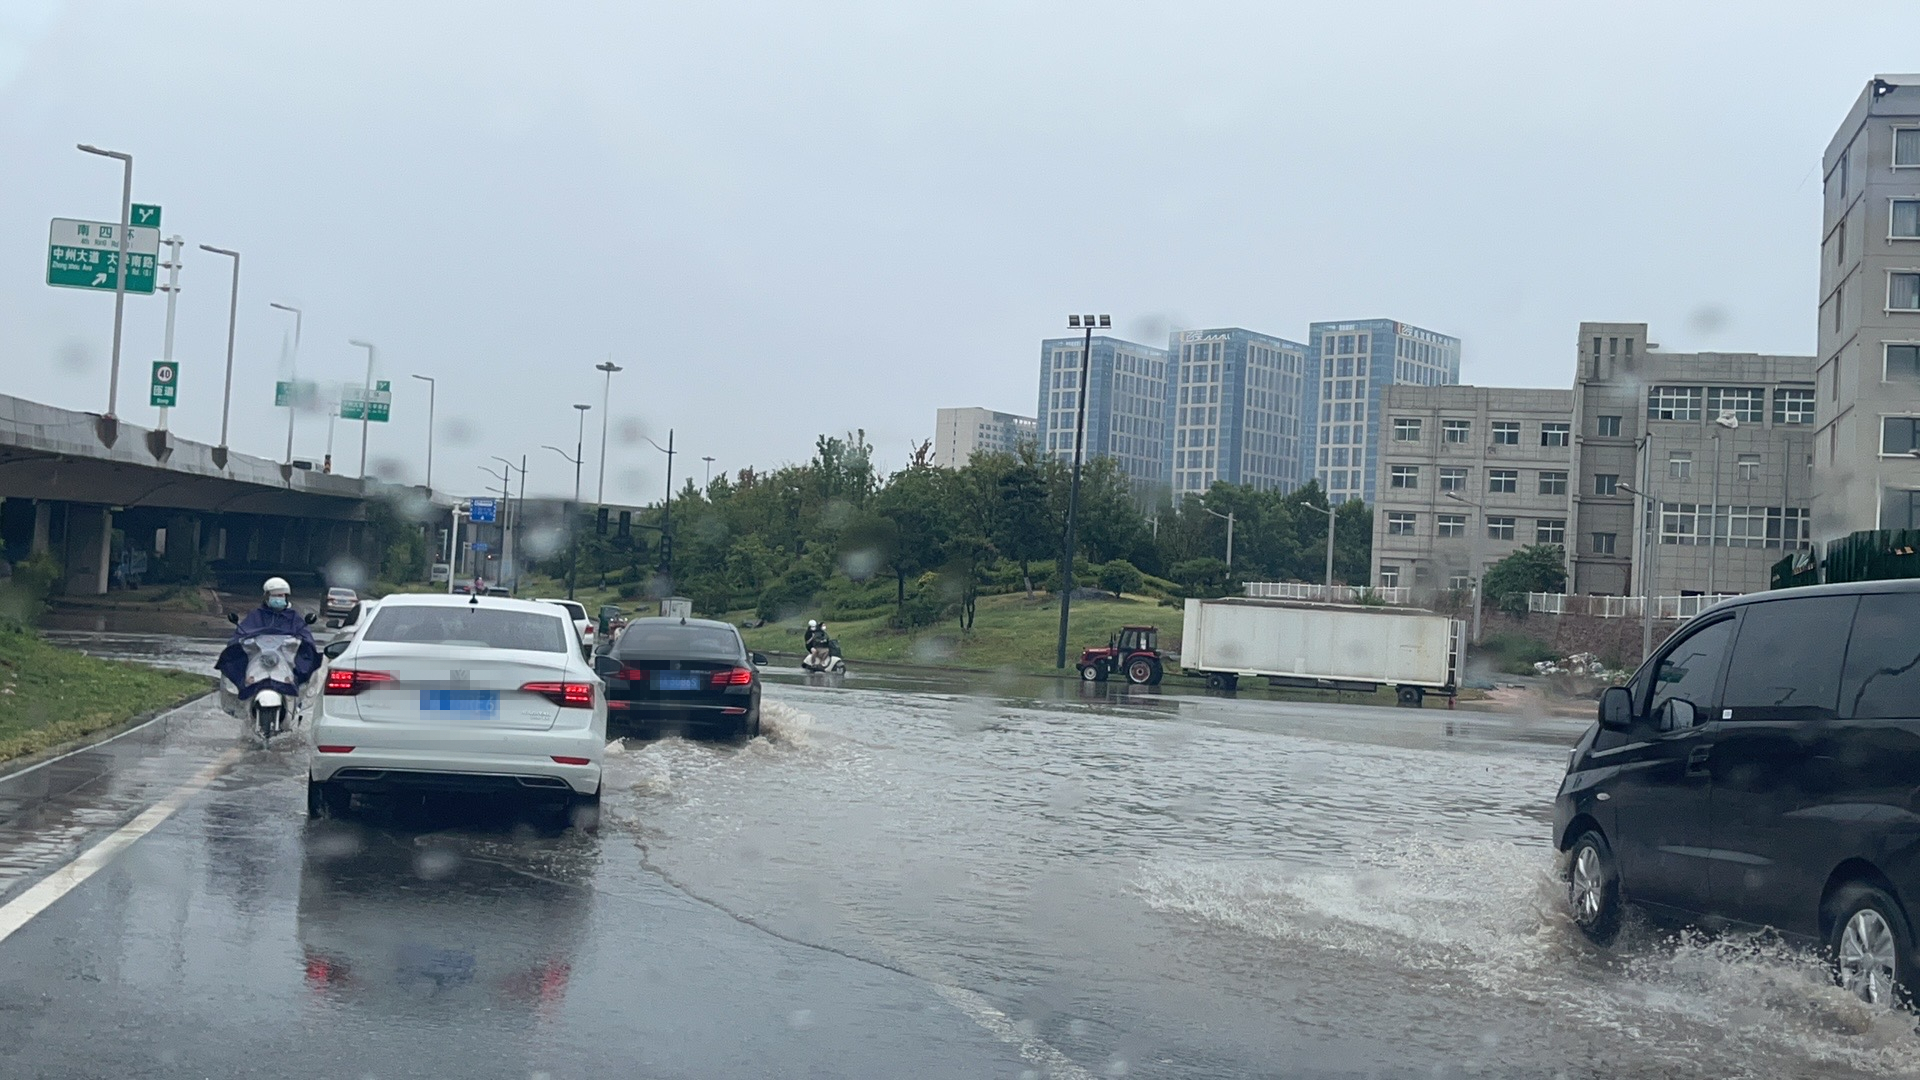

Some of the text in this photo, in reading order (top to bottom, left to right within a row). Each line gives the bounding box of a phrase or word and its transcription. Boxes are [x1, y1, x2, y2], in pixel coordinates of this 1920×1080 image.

[53, 248, 100, 264] 中州大道
[159, 369, 171, 379] 40
